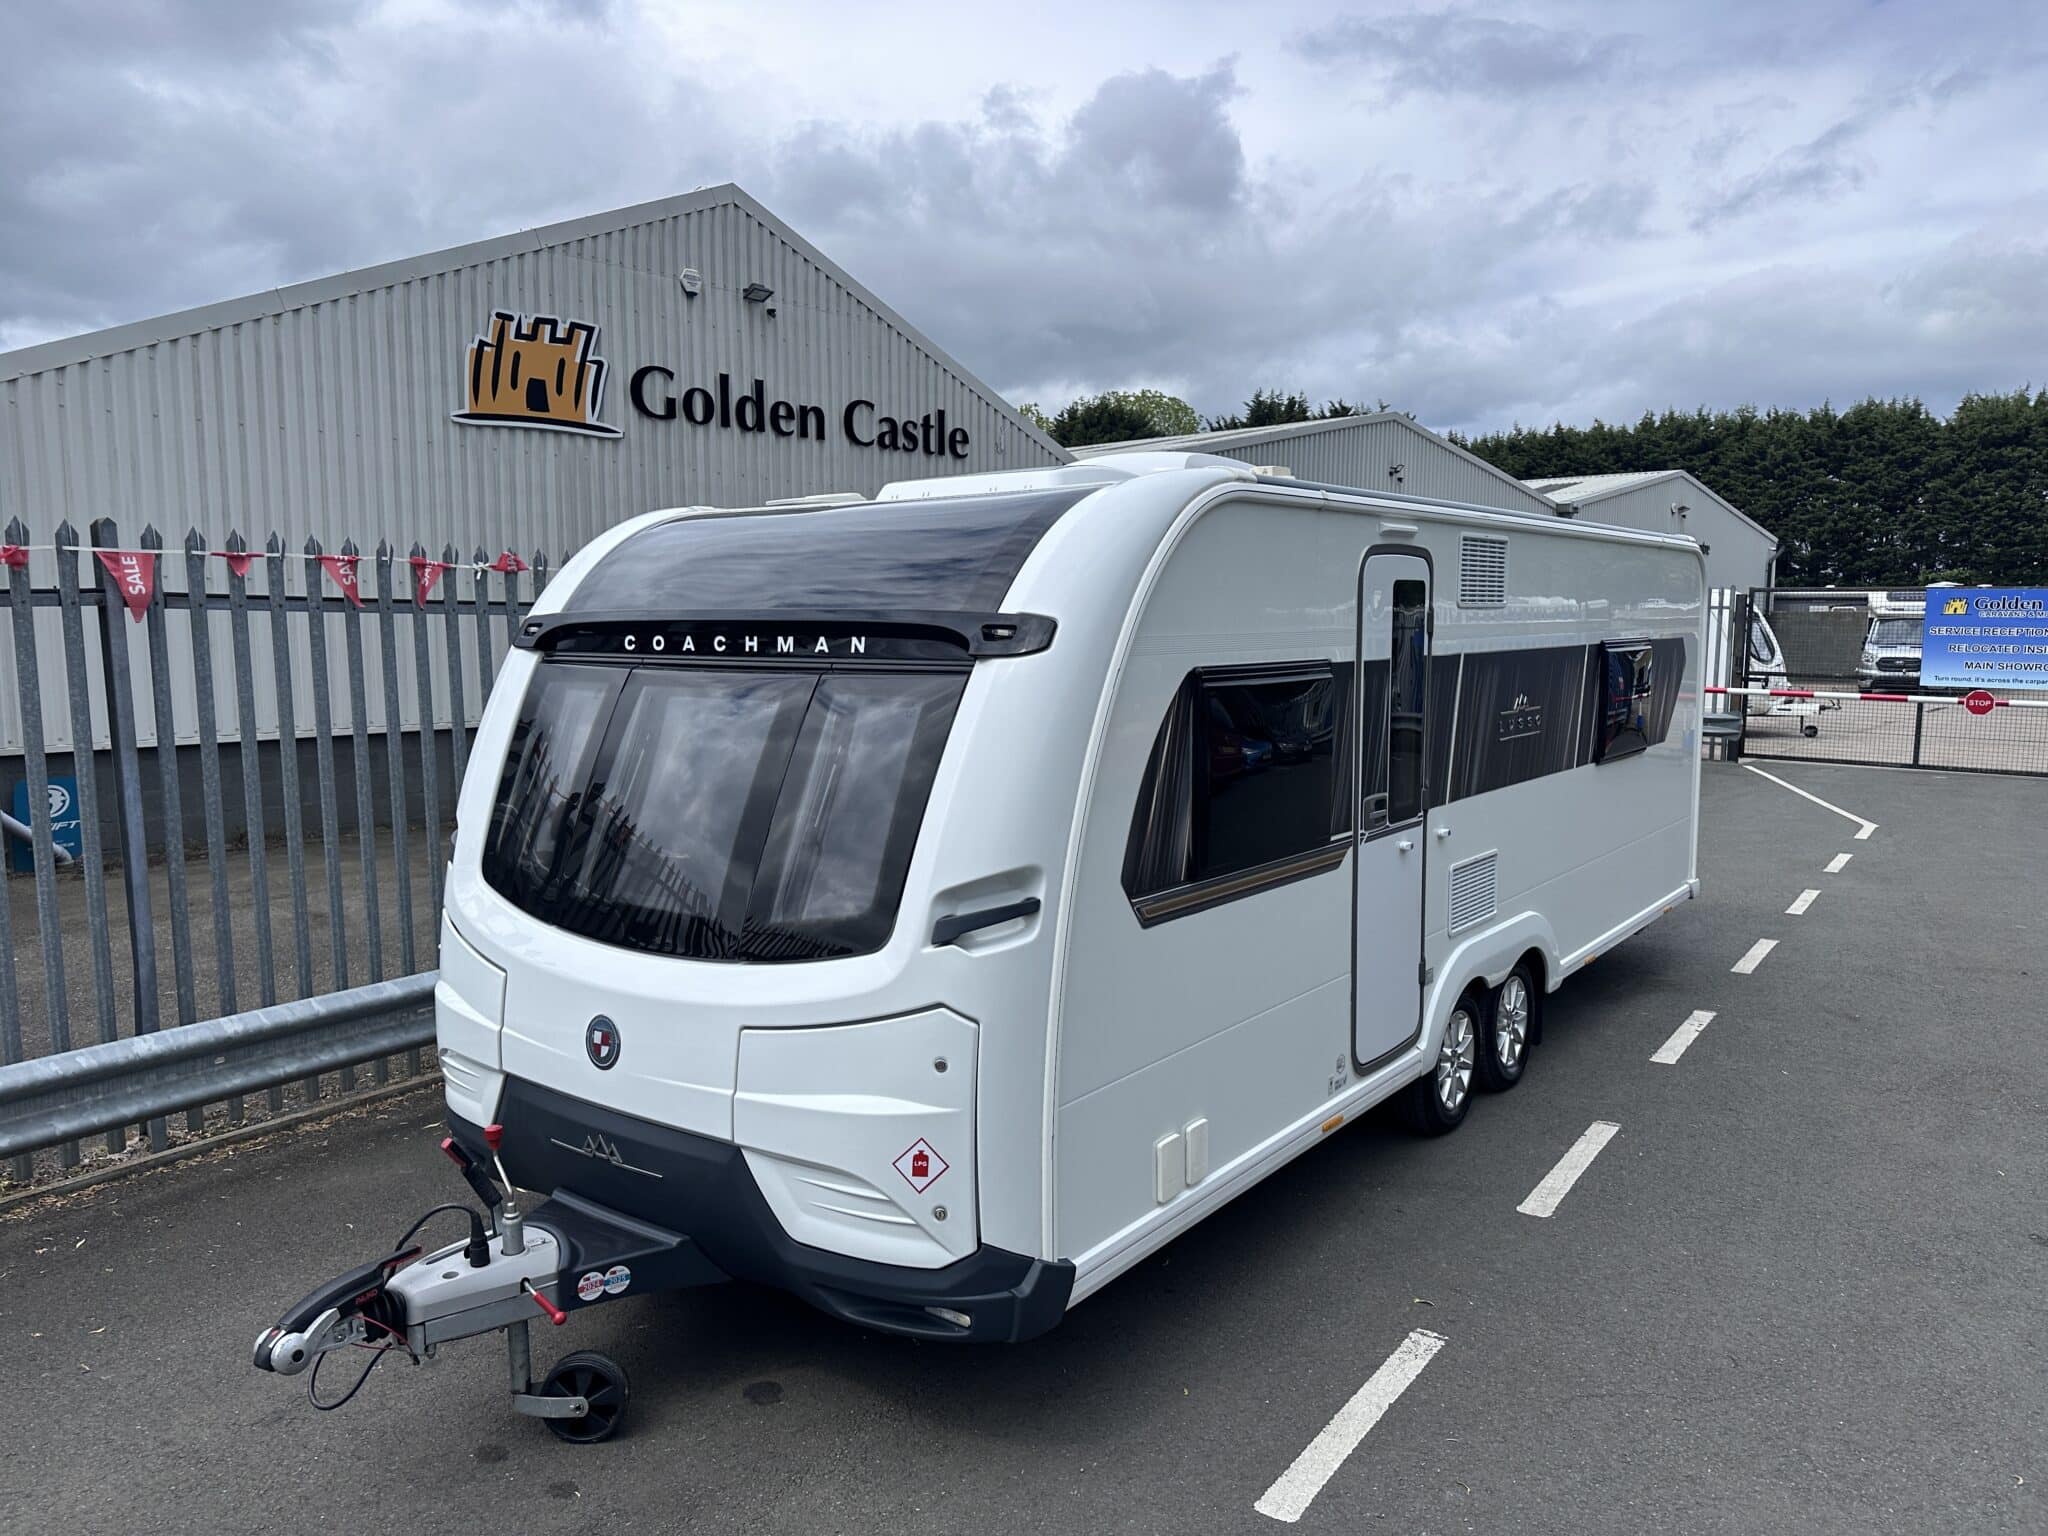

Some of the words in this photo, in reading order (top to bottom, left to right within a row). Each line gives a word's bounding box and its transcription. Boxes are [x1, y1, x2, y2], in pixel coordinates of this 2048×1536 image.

[629, 364, 826, 441] Golden
[843, 399, 970, 459] Castle
[121, 555, 147, 595] SALE
[1974, 596, 2043, 610] Golden
[1930, 626, 1980, 636] SERVICE
[624, 634, 867, 654] COACHMAN
[1948, 644, 2020, 654] RELOCATED
[1964, 661, 1994, 671] MAIN
[1499, 714, 1542, 733] LUSSO
[913, 1160, 928, 1168] LPG
